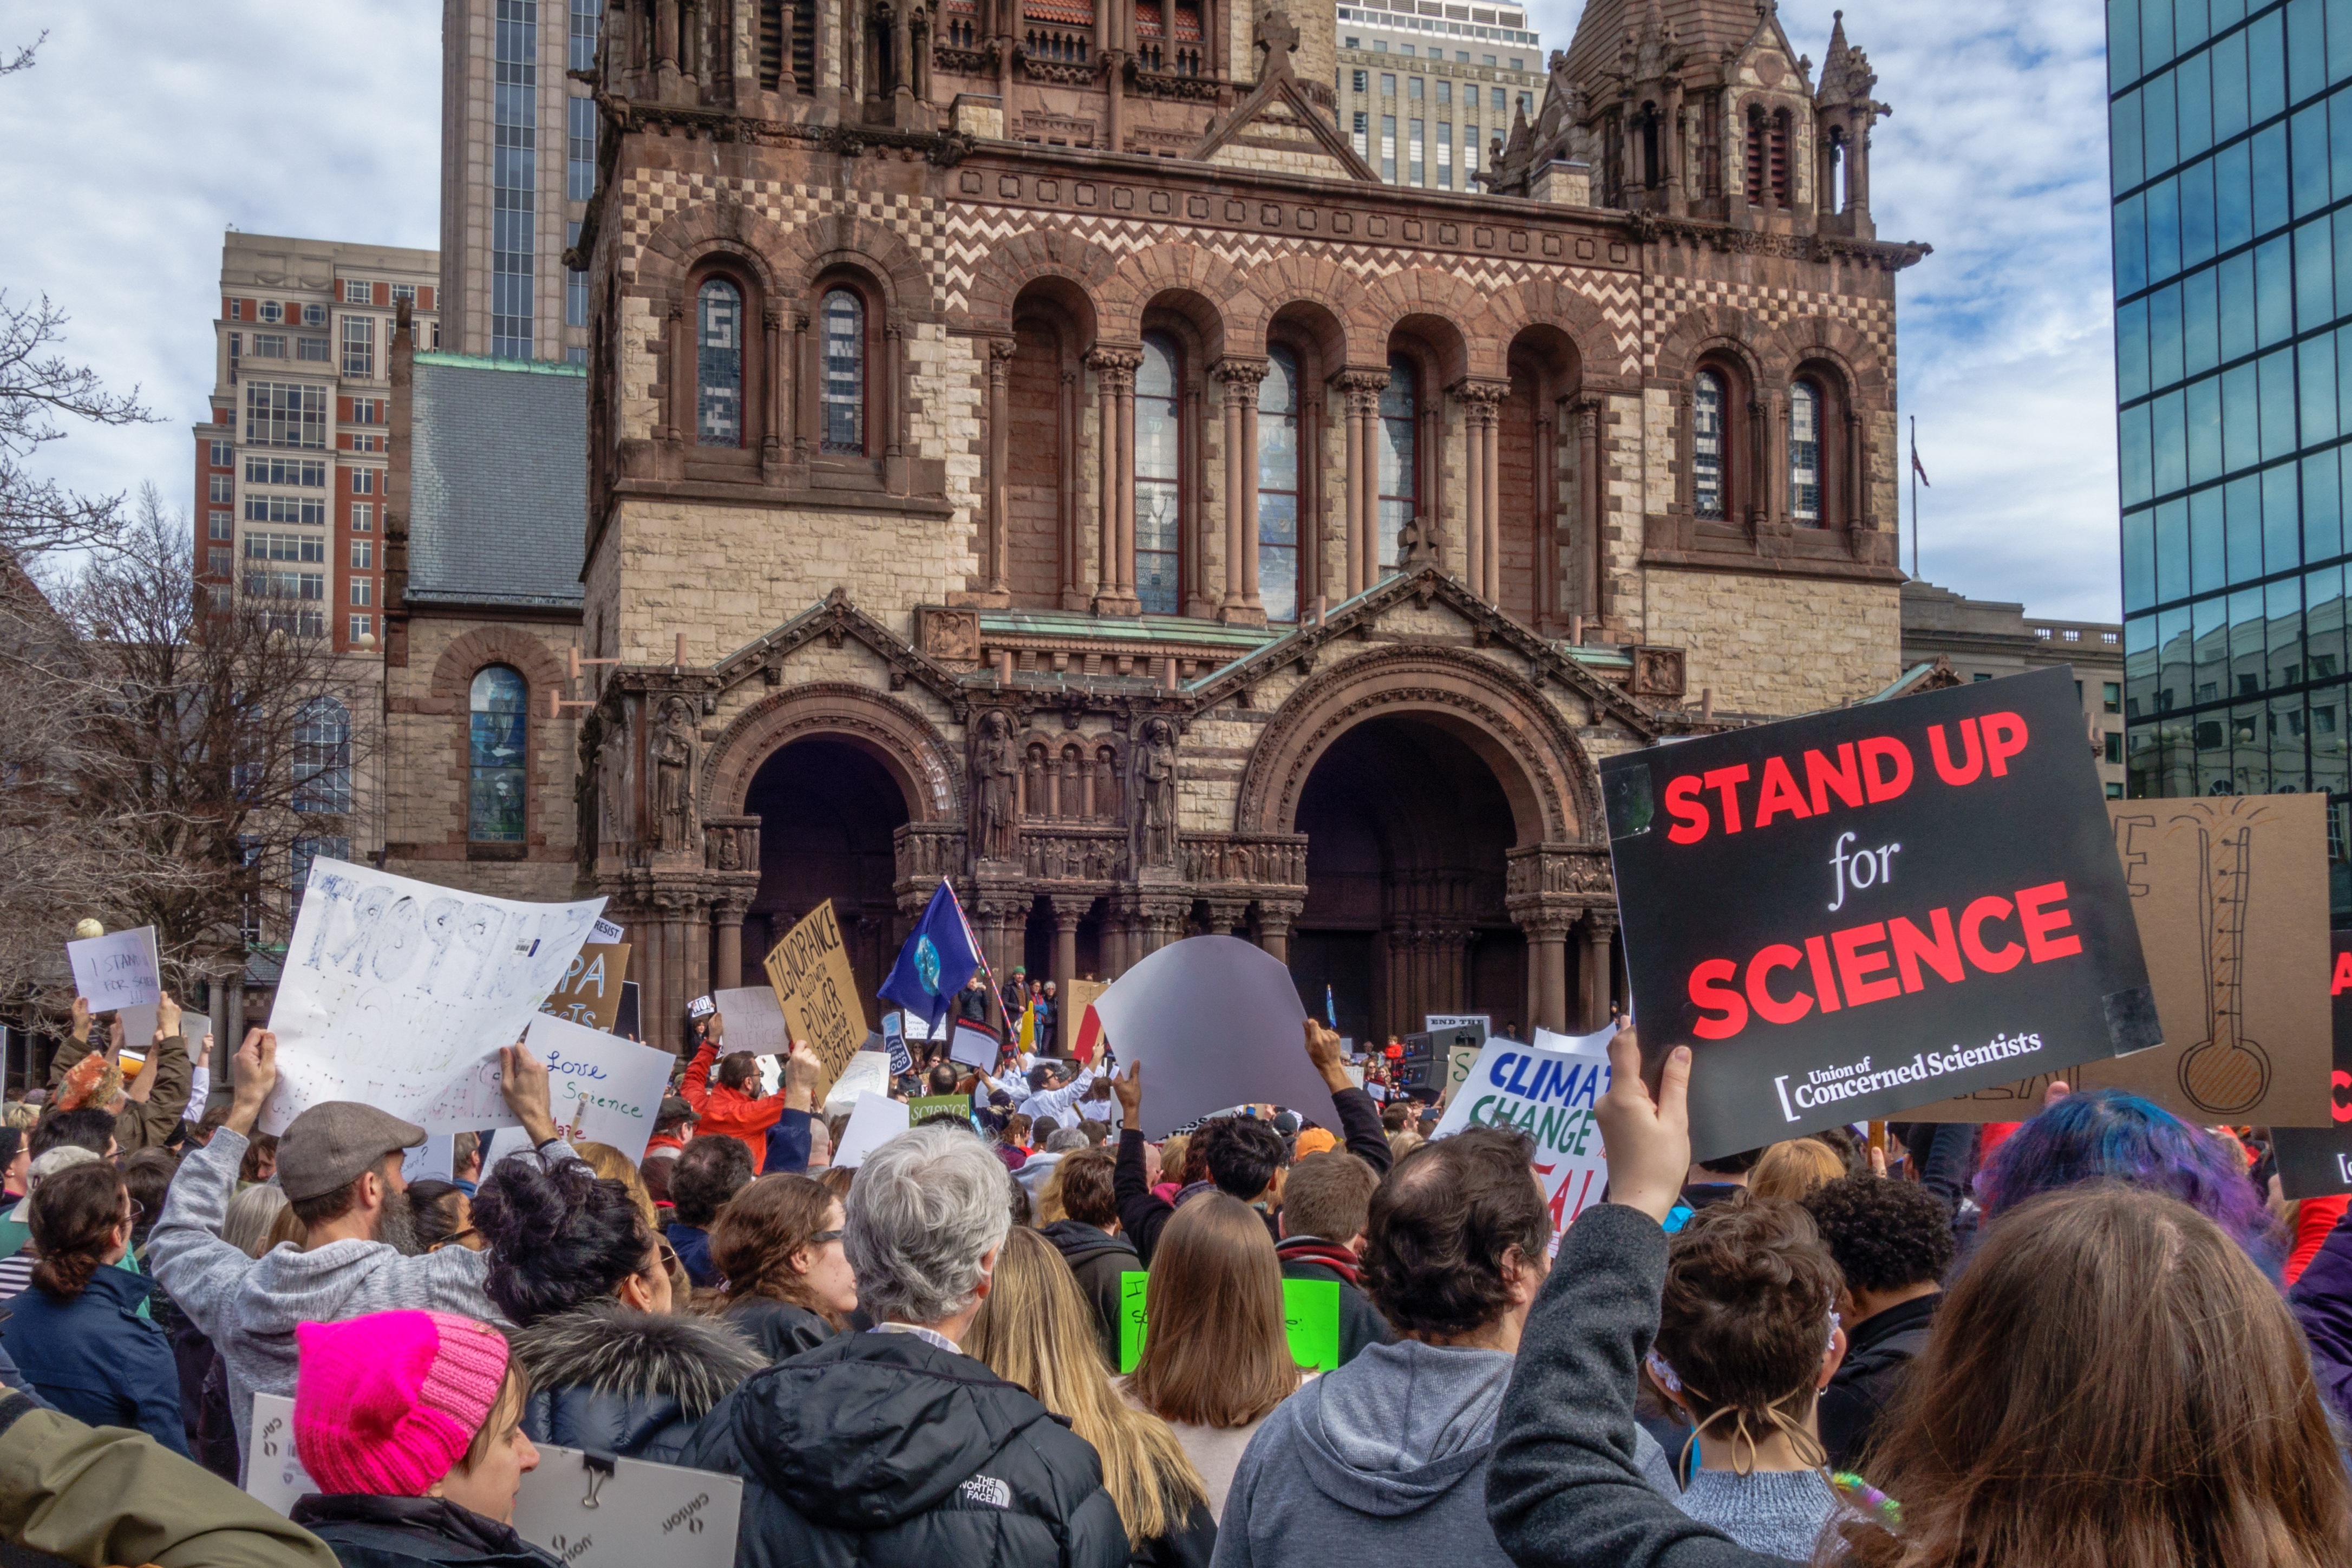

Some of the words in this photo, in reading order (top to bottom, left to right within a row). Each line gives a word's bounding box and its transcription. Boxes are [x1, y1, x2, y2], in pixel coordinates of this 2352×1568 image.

[1664, 736, 1915, 845] STAND
[1927, 710, 2029, 787] UP
[1827, 832, 1900, 911] for
[593, 919, 620, 939] RESIST
[90, 957, 99, 977] I
[769, 905, 840, 1002] IGNORANCE
[1688, 880, 2082, 1040] SCIENCE
[104, 979, 129, 992] FOR
[550, 952, 605, 998] PA
[799, 973, 816, 1002] ALLIED
[813, 961, 827, 983] WITH
[693, 997, 711, 1012] NO!
[800, 976, 842, 1049] POWER
[839, 1011, 847, 1029] OF
[546, 1050, 606, 1080] Love
[890, 1056, 907, 1071] OOD
[891, 1050, 905, 1061] MMON
[1794, 1054, 1929, 1110] Concerned
[1927, 1031, 2042, 1077] Scientists
[1807, 1063, 1855, 1085] Union
[1854, 1056, 1872, 1074] of
[562, 1081, 643, 1119] Science
[1469, 1094, 1598, 1157] CHANGE
[959, 1480, 994, 1495] NORTH
[976, 1474, 996, 1487] THE
[966, 1489, 992, 1503] FACE
